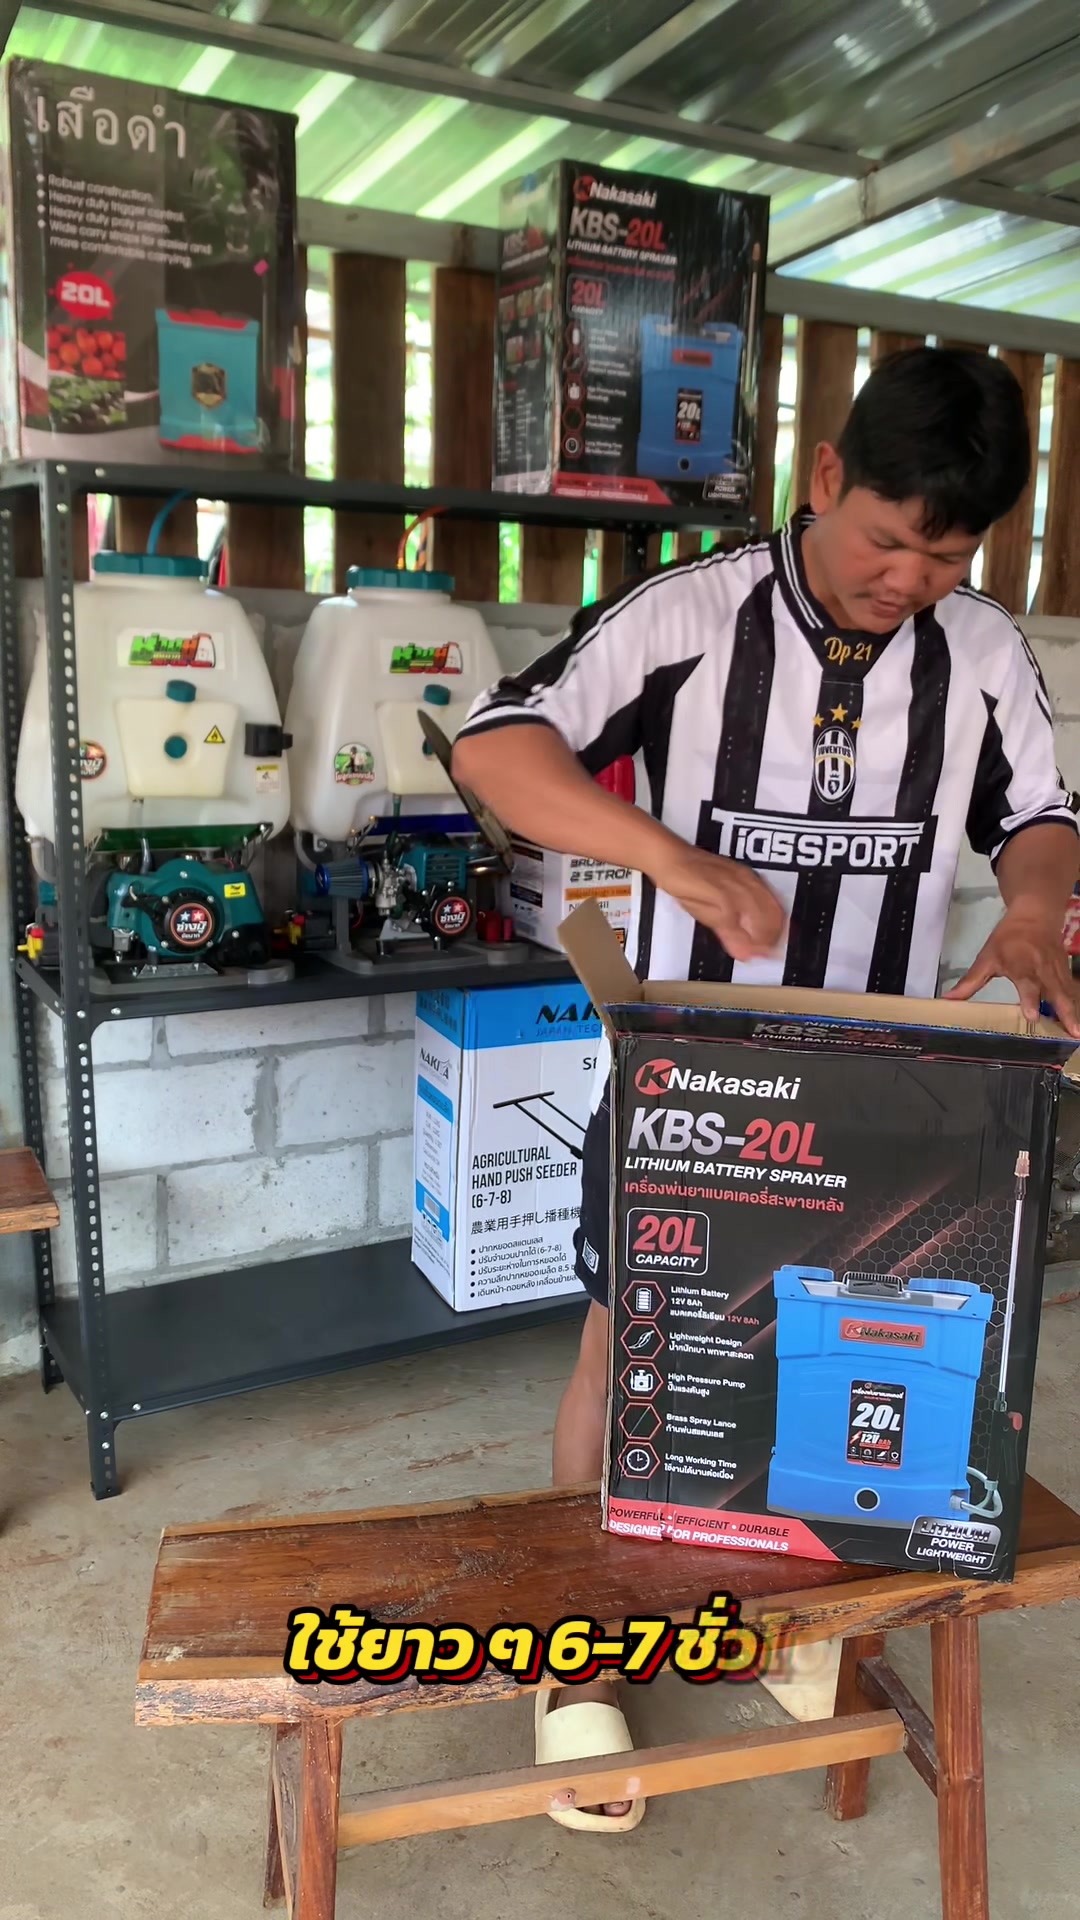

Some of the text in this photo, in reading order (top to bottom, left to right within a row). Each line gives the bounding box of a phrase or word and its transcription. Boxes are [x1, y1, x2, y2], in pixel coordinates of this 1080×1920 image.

[36, 85, 186, 159] เสือดำ
[589, 181, 658, 208] Nakasaki
[569, 206, 666, 251] KBS-20L
[61, 281, 110, 308] 20L
[572, 280, 606, 307] 20L
[824, 636, 872, 665] Dp 21
[570, 871, 580, 882] 2
[577, 1024, 602, 1033] TEC
[754, 1023, 897, 1043] KBS-20L
[752, 1033, 923, 1051] LITHIUM BATTERY SPRAYER
[667, 1067, 801, 1100] Nakasaki
[627, 1106, 823, 1166] KBS-20L
[472, 1146, 551, 1170] AGRICULTURAL
[472, 1161, 577, 1189] HAND PUSH SEEDER
[625, 1156, 847, 1188] LITHIUM BATTERY SPRAYER
[472, 1189, 511, 1208] (6-7-8)
[624, 1175, 844, 1213] เครื่องพ่นยาแบตเตอรี่สะพายหลัง
[632, 1214, 703, 1255] 20L
[478, 1237, 543, 1253] ปากหยอดสแตนเลส
[478, 1244, 562, 1264] ปรับจำนวนปากได้ (6-7-8)
[478, 1253, 567, 1275] ปรับระยะห่างในการหยอดได้
[557, 1264, 570, 1272] 8.5
[635, 1254, 699, 1268] CAPACITY
[670, 1285, 729, 1300] Lithium Battery
[671, 1298, 685, 1306] 12V
[727, 1315, 742, 1324] 12V
[743, 1317, 760, 1325] 8Ah
[669, 1332, 743, 1348] Lightweight Design
[860, 1326, 921, 1342] Nakasaki
[667, 1372, 746, 1389] High Pressure Pump
[666, 1413, 737, 1428] Brass Spray Lance
[851, 1402, 901, 1432] 20L
[665, 1453, 737, 1469] Long Working Time
[609, 1507, 790, 1537] POWERFUL EFFICIENT DURABLE
[692, 1532, 789, 1551] PROFESSIONALS
[931, 1537, 974, 1552] POWER
[916, 1547, 987, 1564] LIGHTWEIGHT
